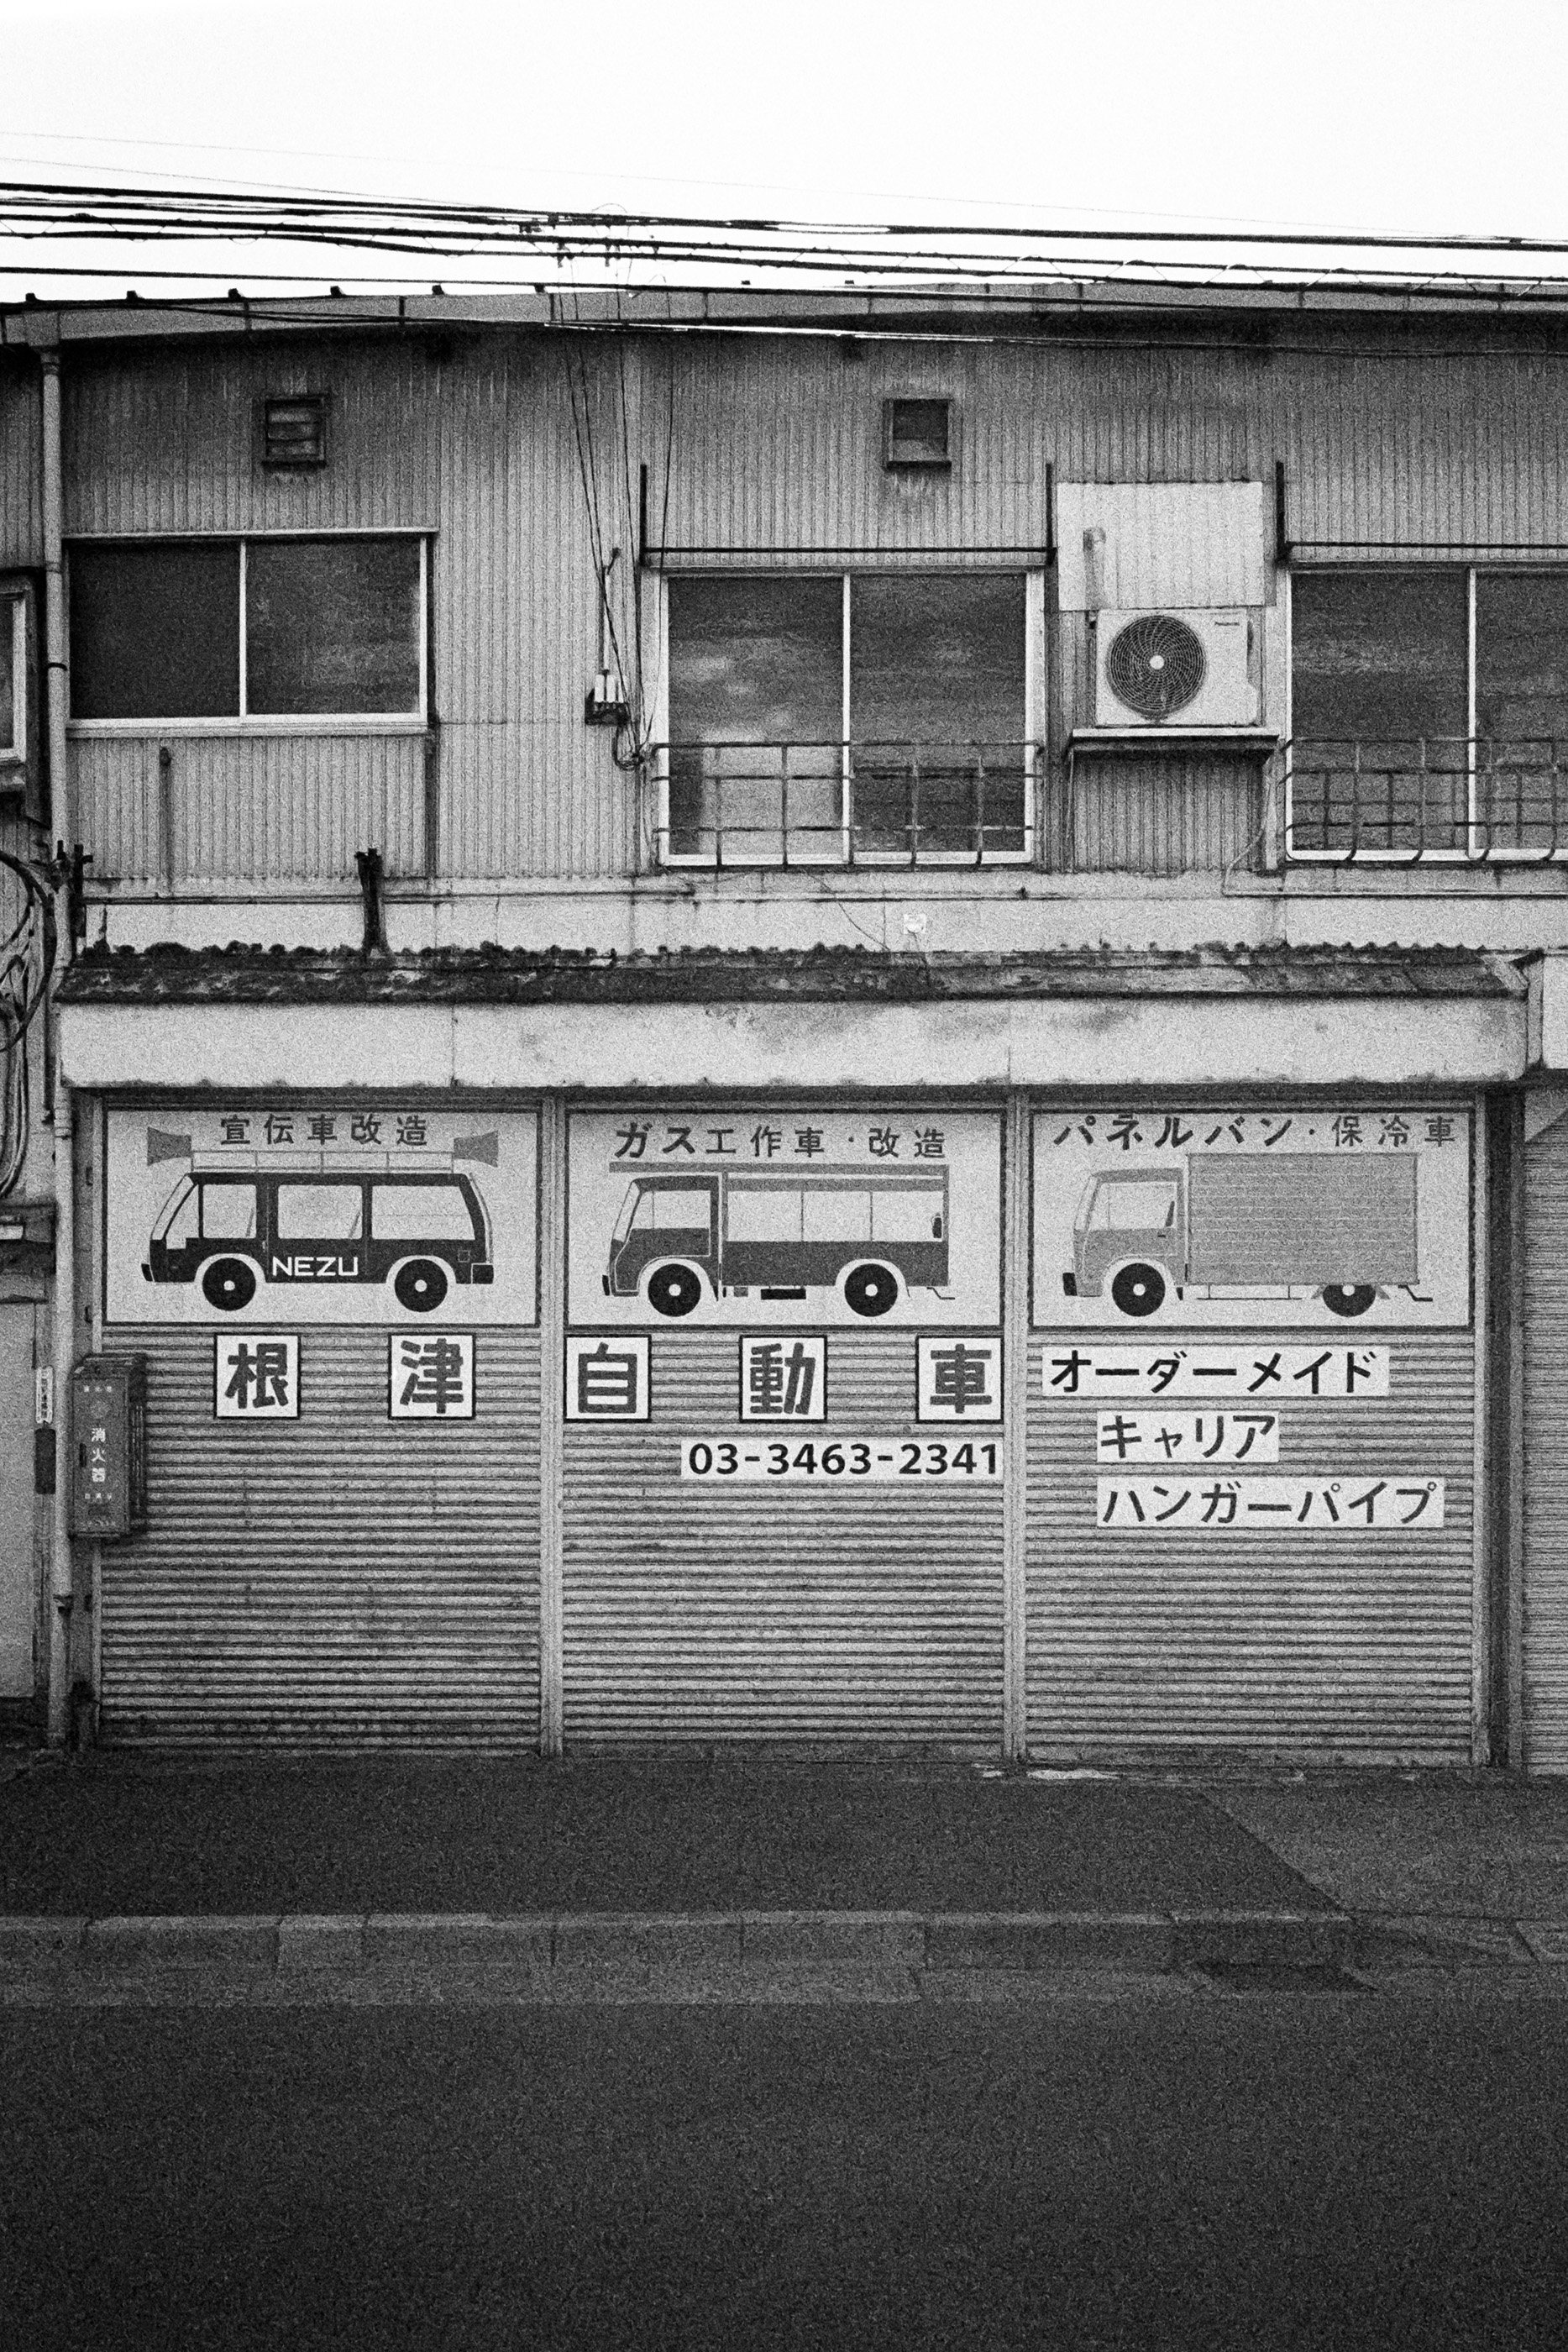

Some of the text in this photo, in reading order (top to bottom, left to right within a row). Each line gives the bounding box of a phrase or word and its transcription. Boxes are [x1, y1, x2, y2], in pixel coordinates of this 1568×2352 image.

[220, 1114, 428, 1146] 宣伝車改造
[272, 1256, 359, 1277] NEZU
[1051, 1350, 1376, 1394] オーダーメイド
[1101, 1415, 1275, 1459] キャリア
[689, 1442, 997, 1476] 03-3463-2341
[1102, 1481, 1438, 1525] ハンガーパイプ
